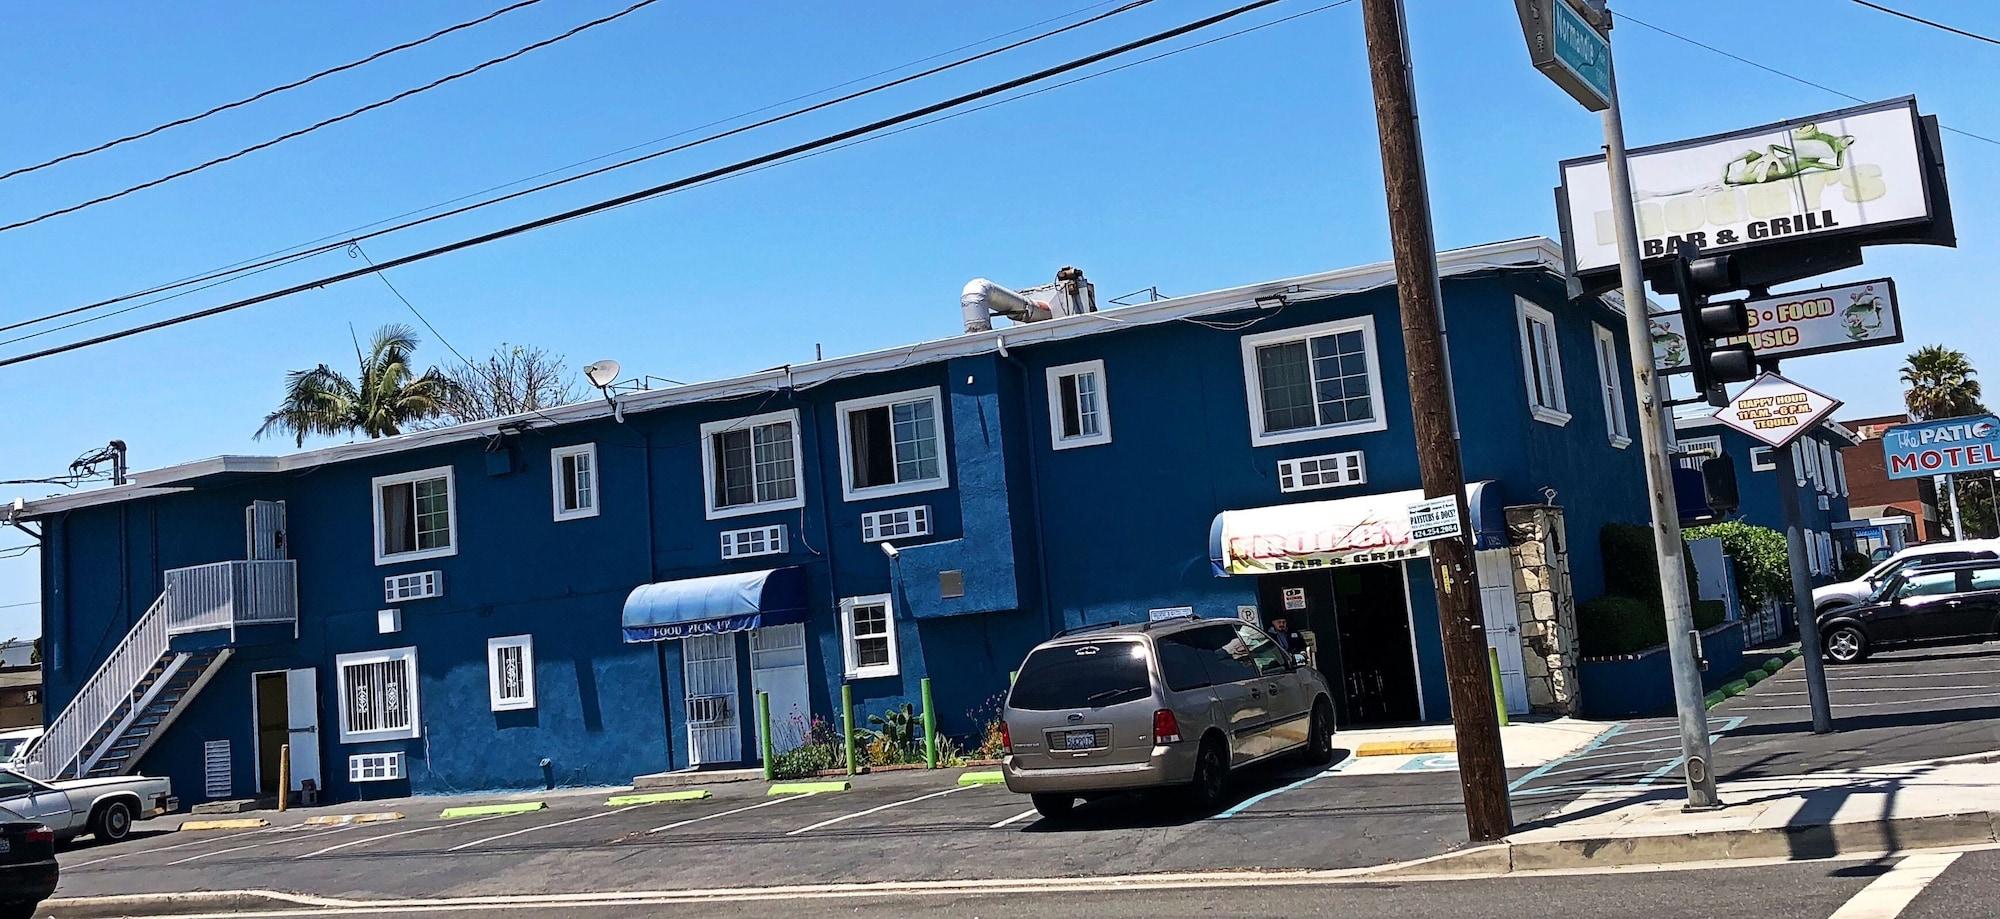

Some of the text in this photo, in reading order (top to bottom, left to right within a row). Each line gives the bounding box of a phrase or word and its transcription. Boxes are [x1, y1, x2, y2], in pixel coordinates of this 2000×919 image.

[1643, 209, 1838, 257] BAR & GRILL
[1777, 298, 1833, 322] FOOD
[1738, 393, 1807, 409] HAPPY HOUR
[1753, 416, 1798, 429] TEQUILA
[1888, 430, 1920, 448] The
[1890, 443, 2000, 474] MOTEL
[1275, 558, 1322, 571] BAR
[653, 627, 682, 637] FOOD
[688, 622, 712, 633] PICK
